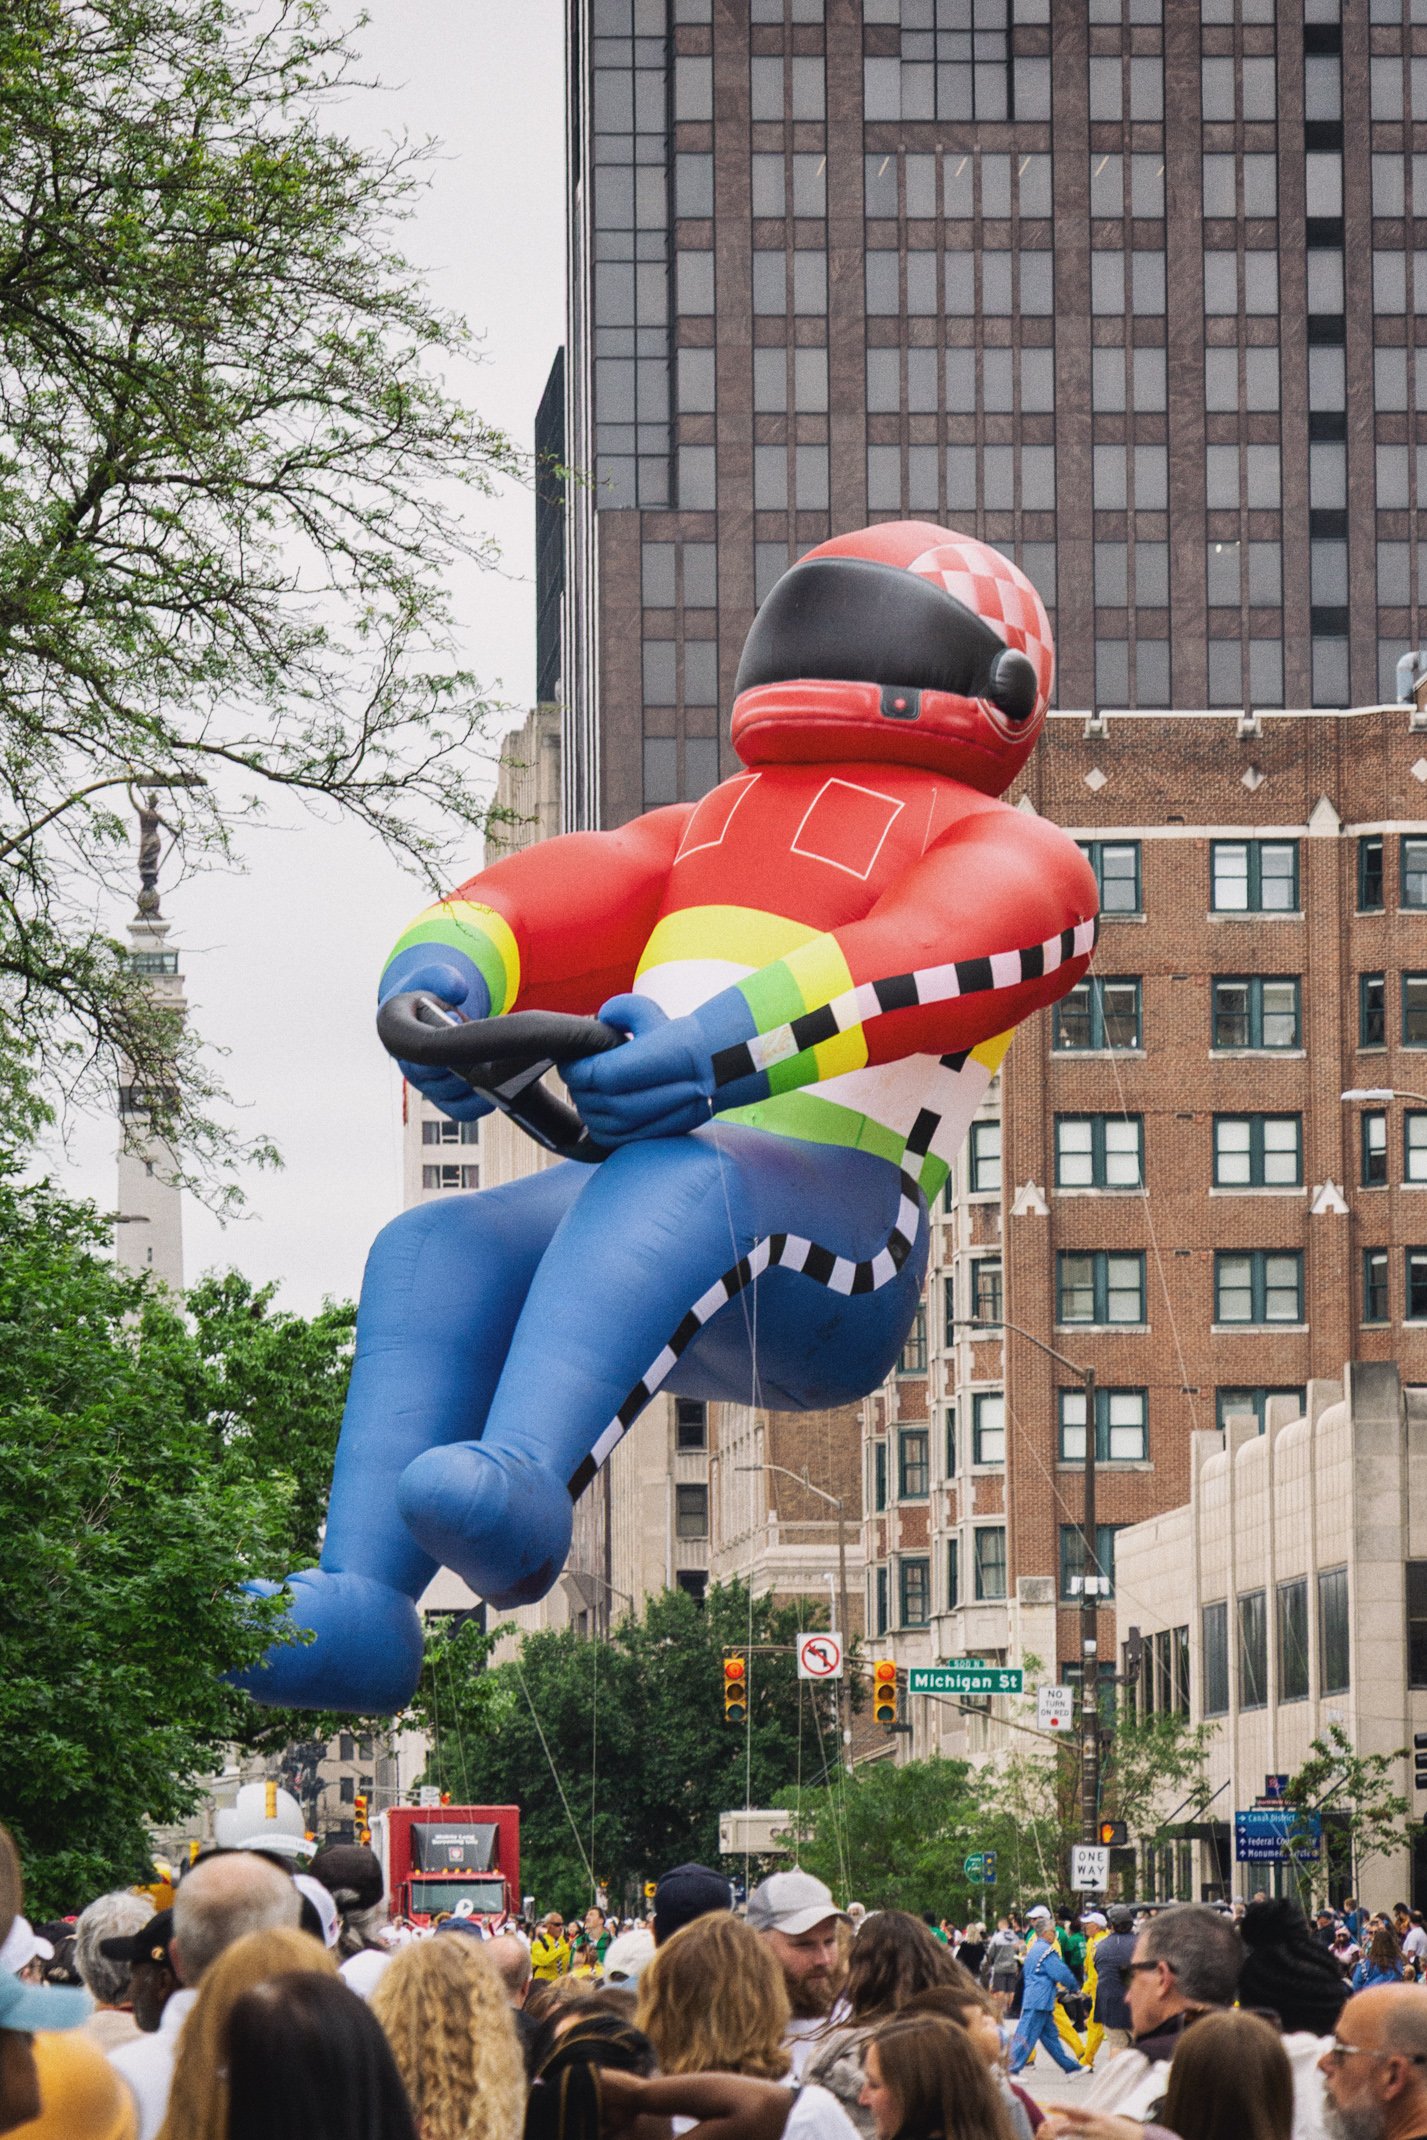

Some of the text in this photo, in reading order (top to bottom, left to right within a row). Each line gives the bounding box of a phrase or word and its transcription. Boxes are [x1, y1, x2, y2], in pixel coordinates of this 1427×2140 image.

[915, 1673, 1018, 1692] Michigan St
[1048, 1690, 1063, 1699] NO
[1248, 1837, 1275, 1846] Federal
[1078, 1851, 1104, 1861] ONE
[1077, 1865, 1105, 1876] WAY
